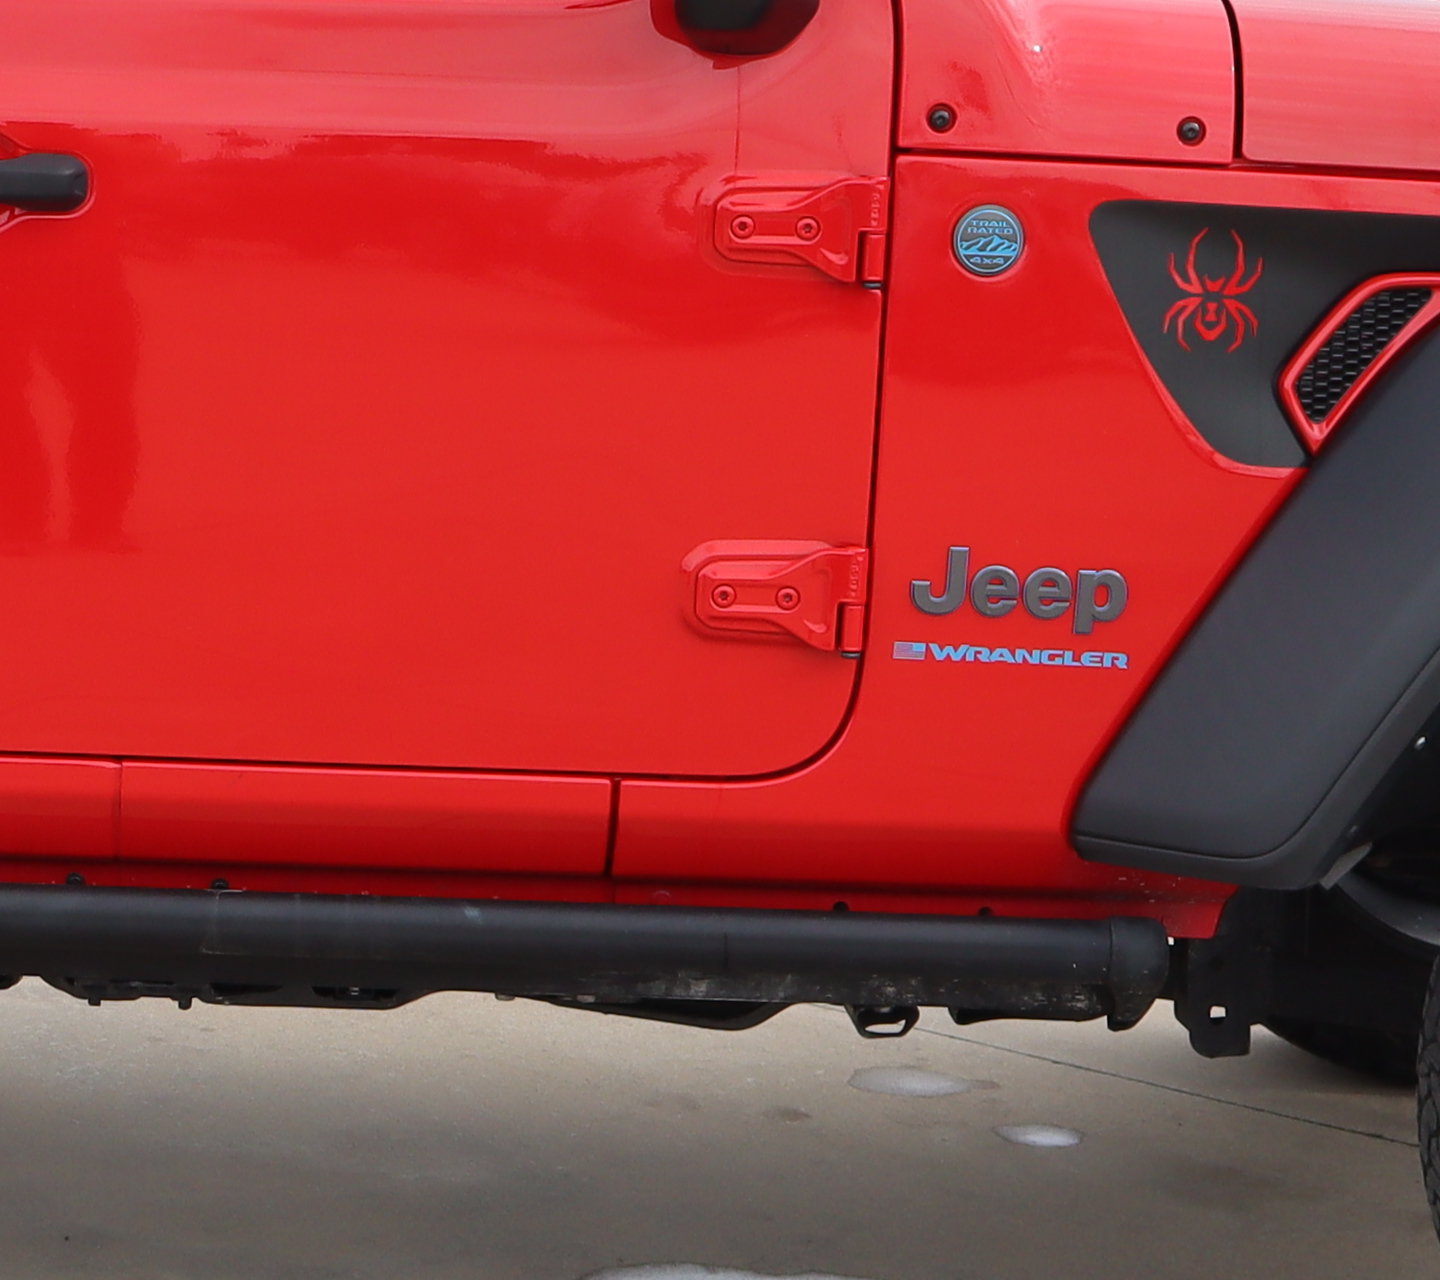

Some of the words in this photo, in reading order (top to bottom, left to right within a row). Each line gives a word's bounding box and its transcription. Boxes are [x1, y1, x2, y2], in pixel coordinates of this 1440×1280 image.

[967, 226, 1014, 235] RATED
[909, 545, 1128, 635] Jeep
[928, 642, 1129, 670] WRANGLER
